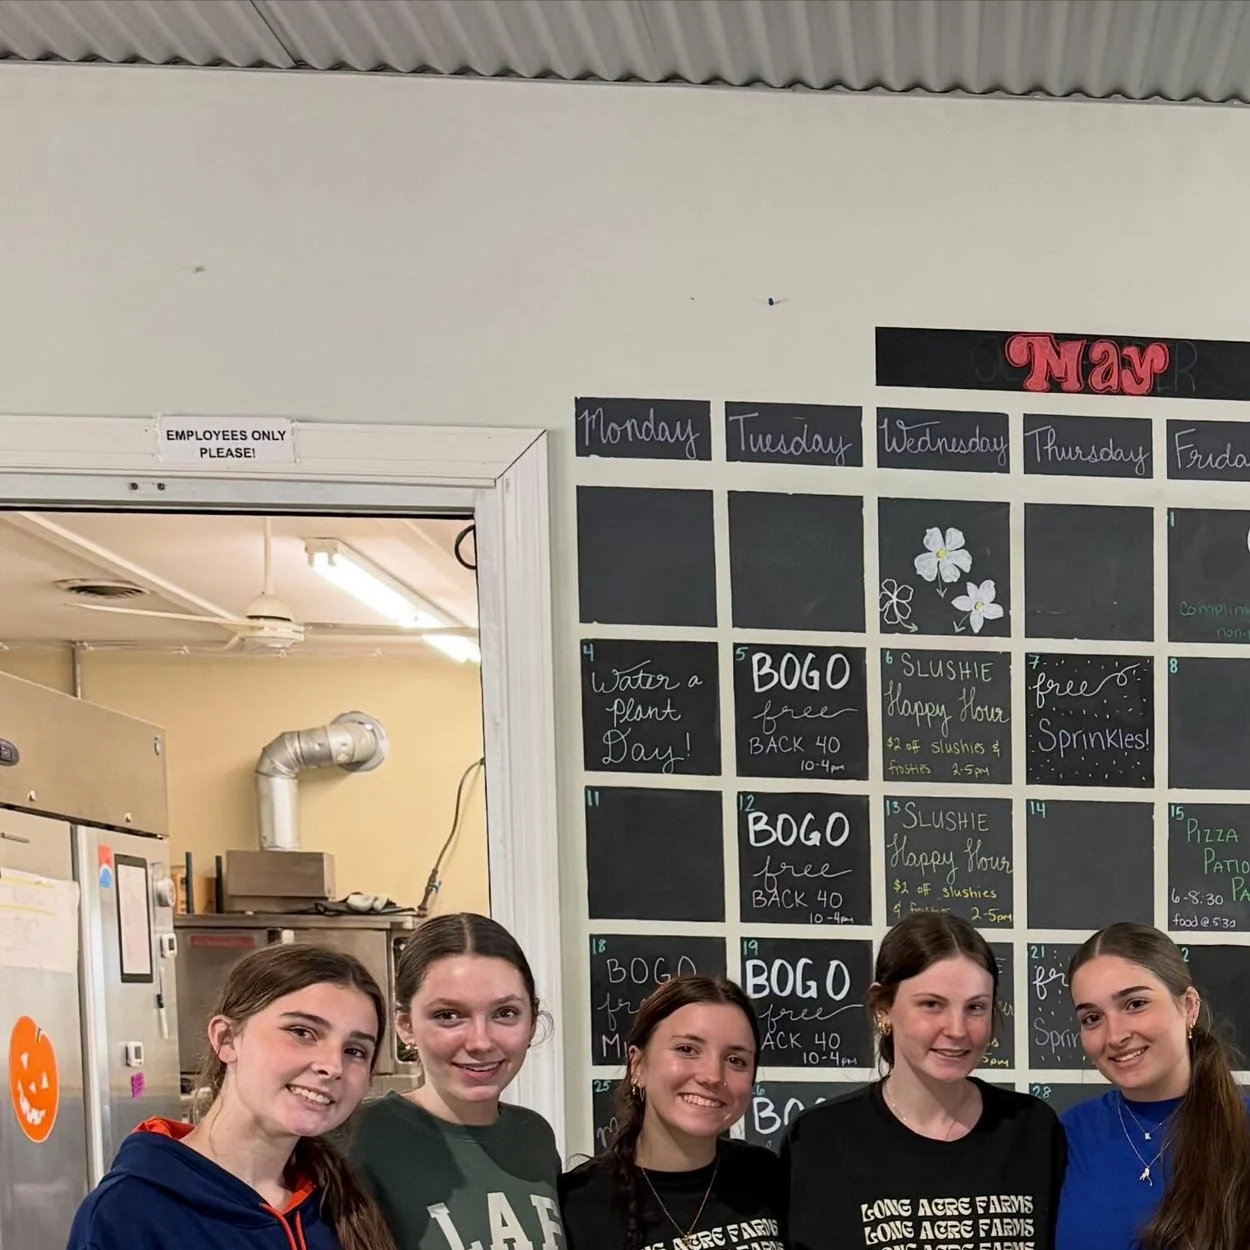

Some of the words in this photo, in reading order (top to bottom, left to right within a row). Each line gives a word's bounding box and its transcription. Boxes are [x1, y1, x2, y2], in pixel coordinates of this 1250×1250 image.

[1005, 332, 1170, 396] May
[166, 430, 248, 441] EMPLOYEES
[251, 430, 287, 441] ONLY
[578, 408, 700, 459] Monday
[729, 412, 852, 466] Tuesday
[878, 418, 1008, 467] Wednesday
[200, 447, 256, 458] PLEASE!
[1027, 425, 1150, 476] Thursday
[583, 644, 594, 662] 4
[735, 646, 749, 661] 5
[884, 651, 893, 665] 6
[1028, 655, 1041, 670] 7
[592, 660, 681, 693] Water
[688, 674, 703, 689] a
[751, 652, 851, 693] BOGO
[901, 652, 995, 683] SLUSHIE
[1169, 659, 1178, 674] 8
[1032, 662, 1142, 709] free
[753, 700, 858, 735] free
[884, 680, 953, 738] Happy
[958, 686, 1010, 724] Hour
[602, 727, 691, 775] Day!
[749, 736, 805, 755] BACK
[815, 736, 841, 755] 40
[887, 737, 902, 751] $2
[905, 738, 921, 755] off
[931, 739, 985, 755] slushies
[587, 790, 600, 806] 11
[738, 795, 757, 812] 12
[885, 800, 901, 816] 13
[902, 801, 990, 832] SLUSHIE
[1030, 801, 1047, 819] 14
[1170, 805, 1185, 820] 15
[748, 811, 850, 847] BOGO
[886, 833, 959, 885] Happy
[964, 838, 1013, 874] Hour
[752, 855, 852, 893] free
[752, 889, 808, 909] BACK
[817, 889, 844, 909] 40
[893, 879, 909, 895] $2
[917, 882, 932, 896] off
[943, 884, 998, 900] slushies
[1172, 913, 1199, 928] food
[592, 939, 607, 953] 18
[743, 940, 759, 955] 19
[1030, 945, 1045, 959] 21
[745, 958, 851, 1000] BOGO
[758, 1003, 865, 1034] free
[760, 1031, 803, 1051] ACK
[814, 1032, 841, 1050] 40
[594, 1080, 612, 1093] 25
[861, 1199, 912, 1222] LONG
[918, 1197, 973, 1217] ACRE
[975, 1195, 1035, 1215] FARMS
[864, 1220, 915, 1246] LONG
[919, 1220, 974, 1240] ACRE
[979, 1218, 1035, 1238] FARMS
